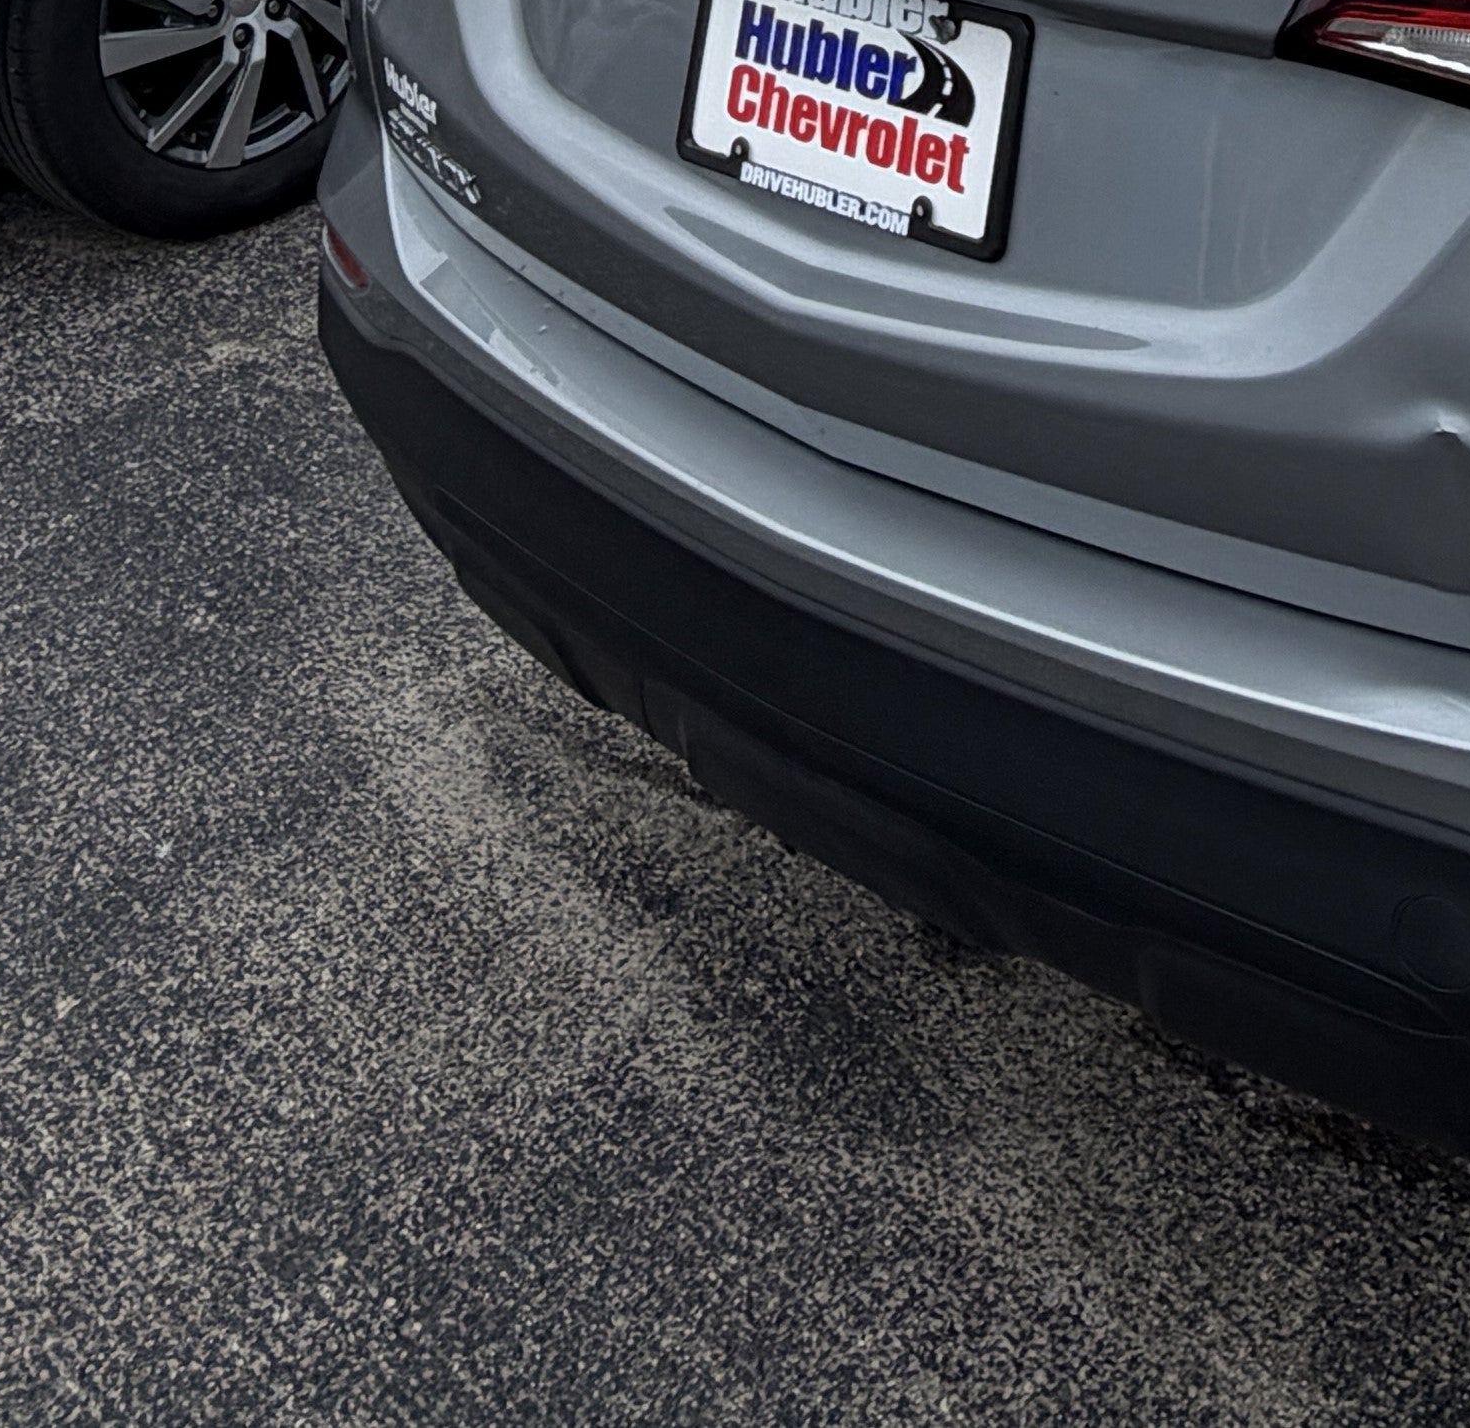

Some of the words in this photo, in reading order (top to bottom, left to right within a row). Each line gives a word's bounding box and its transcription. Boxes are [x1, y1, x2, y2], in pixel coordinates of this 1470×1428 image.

[735, 0, 917, 105] Hubler
[727, 64, 970, 194] Chevrolet
[740, 163, 909, 237] DRIVEHUBLER.COM
